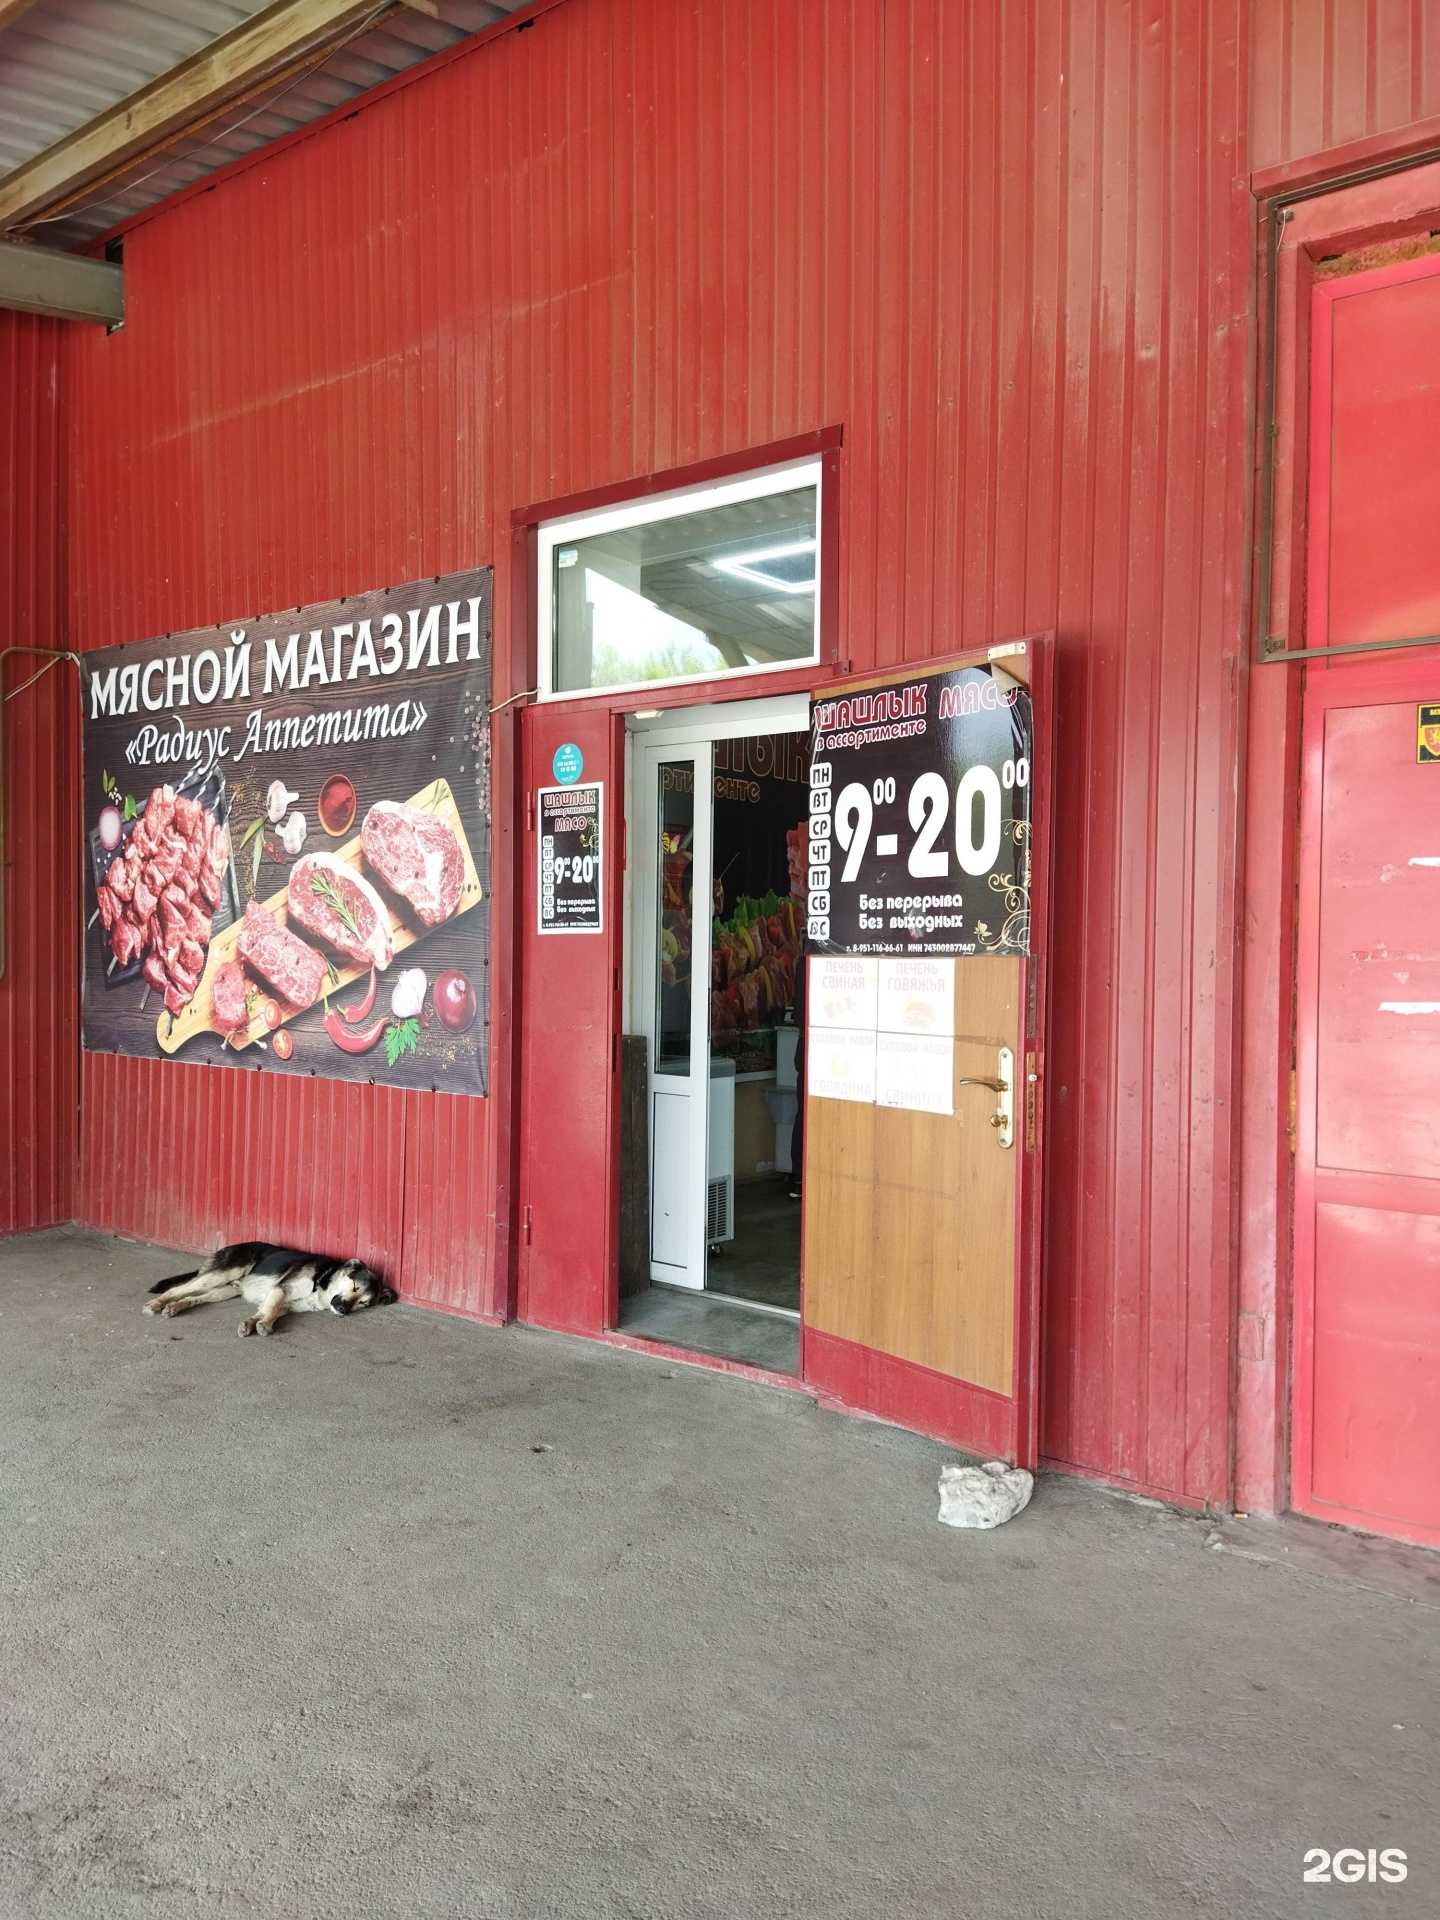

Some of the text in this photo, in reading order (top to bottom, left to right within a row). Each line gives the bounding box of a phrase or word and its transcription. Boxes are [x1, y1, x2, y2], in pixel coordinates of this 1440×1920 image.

[90, 596, 482, 719] МЯСНОЙ МАГАЗИН
[814, 684, 928, 732] ШАШЛЫК
[826, 719, 927, 749] ассортименте
[813, 767, 830, 785] ПН
[813, 792, 828, 809] ВТ
[555, 816, 587, 832] МЯСО
[813, 819, 828, 836] СР
[812, 843, 828, 861] ЧТ
[812, 869, 827, 886] ПТ
[812, 894, 827, 910] СБ
[859, 894, 963, 913] Без перерыва
[809, 921, 827, 936] ВС
[889, 915, 963, 933] выходных
[907, 943, 922, 952] ИНН
[825, 960, 863, 974] ПЕЧЕНЬ
[896, 962, 938, 976] ПЕЧЕНЬ
[822, 975, 865, 990] СВИНАЯ
[887, 977, 945, 992] ГОВЯЖЬЯ
